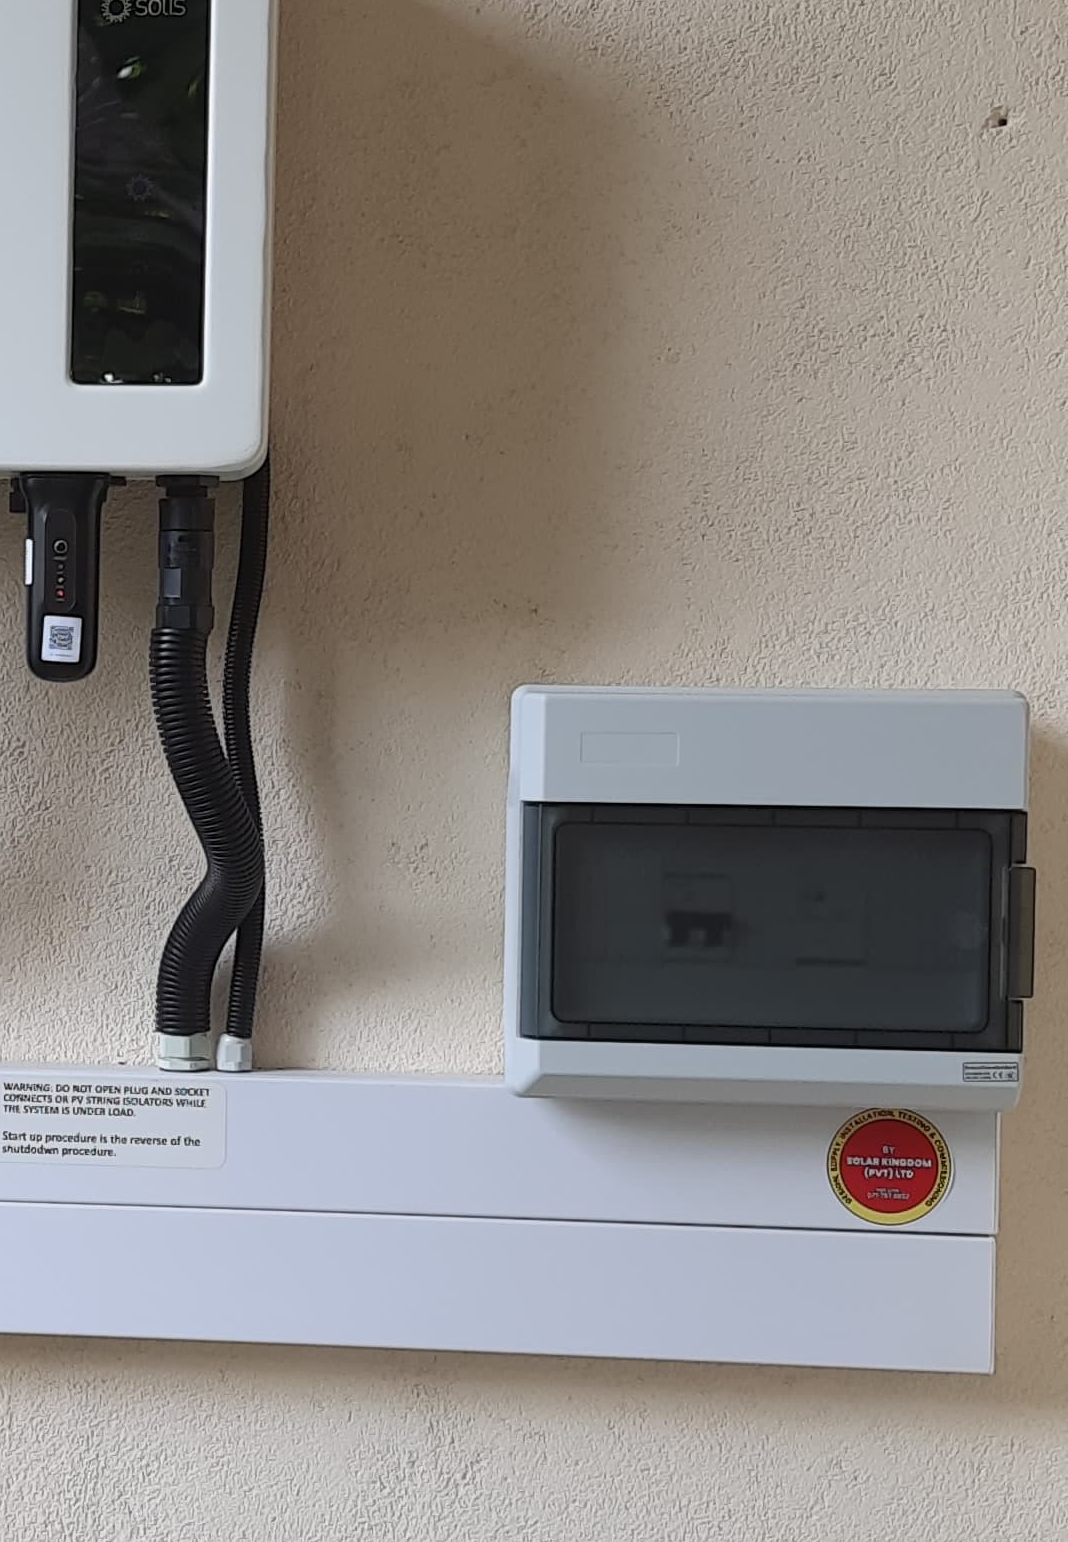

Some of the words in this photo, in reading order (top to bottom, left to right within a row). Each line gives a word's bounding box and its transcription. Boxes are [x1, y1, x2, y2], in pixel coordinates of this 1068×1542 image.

[55, 1084, 70, 1093] DO
[73, 1084, 92, 1093] NOT
[95, 1085, 121, 1094] OPEN
[124, 1086, 148, 1095] PLUG
[151, 1086, 172, 1096] AND
[174, 1087, 210, 1097] SOCKET
[55, 1095, 69, 1104] OR
[71, 1096, 84, 1105] PV
[86, 1096, 121, 1106] STRING
[123, 1097, 173, 1107] ISOLATORS
[3, 1104, 20, 1114] THE
[23, 1105, 59, 1114] SYSTEM
[62, 1106, 70, 1115] IS
[72, 1107, 105, 1116] UNDER
[108, 1108, 136, 1117] LOAD.
[2, 1131, 27, 1141] Start
[29, 1133, 43, 1143] up
[45, 1132, 97, 1144] procedure
[100, 1133, 108, 1143] is
[110, 1134, 127, 1144] the
[130, 1137, 168, 1145] reverse
[170, 1136, 182, 1146] of
[183, 1136, 201, 1146] the
[62, 1146, 117, 1157] procedure.
[883, 1145, 895, 1154] BY
[847, 1157, 880, 1166] SOLAR
[881, 1158, 932, 1168] KINGDOM
[864, 1167, 893, 1179] (PVT)
[895, 1169, 914, 1179] LTD
